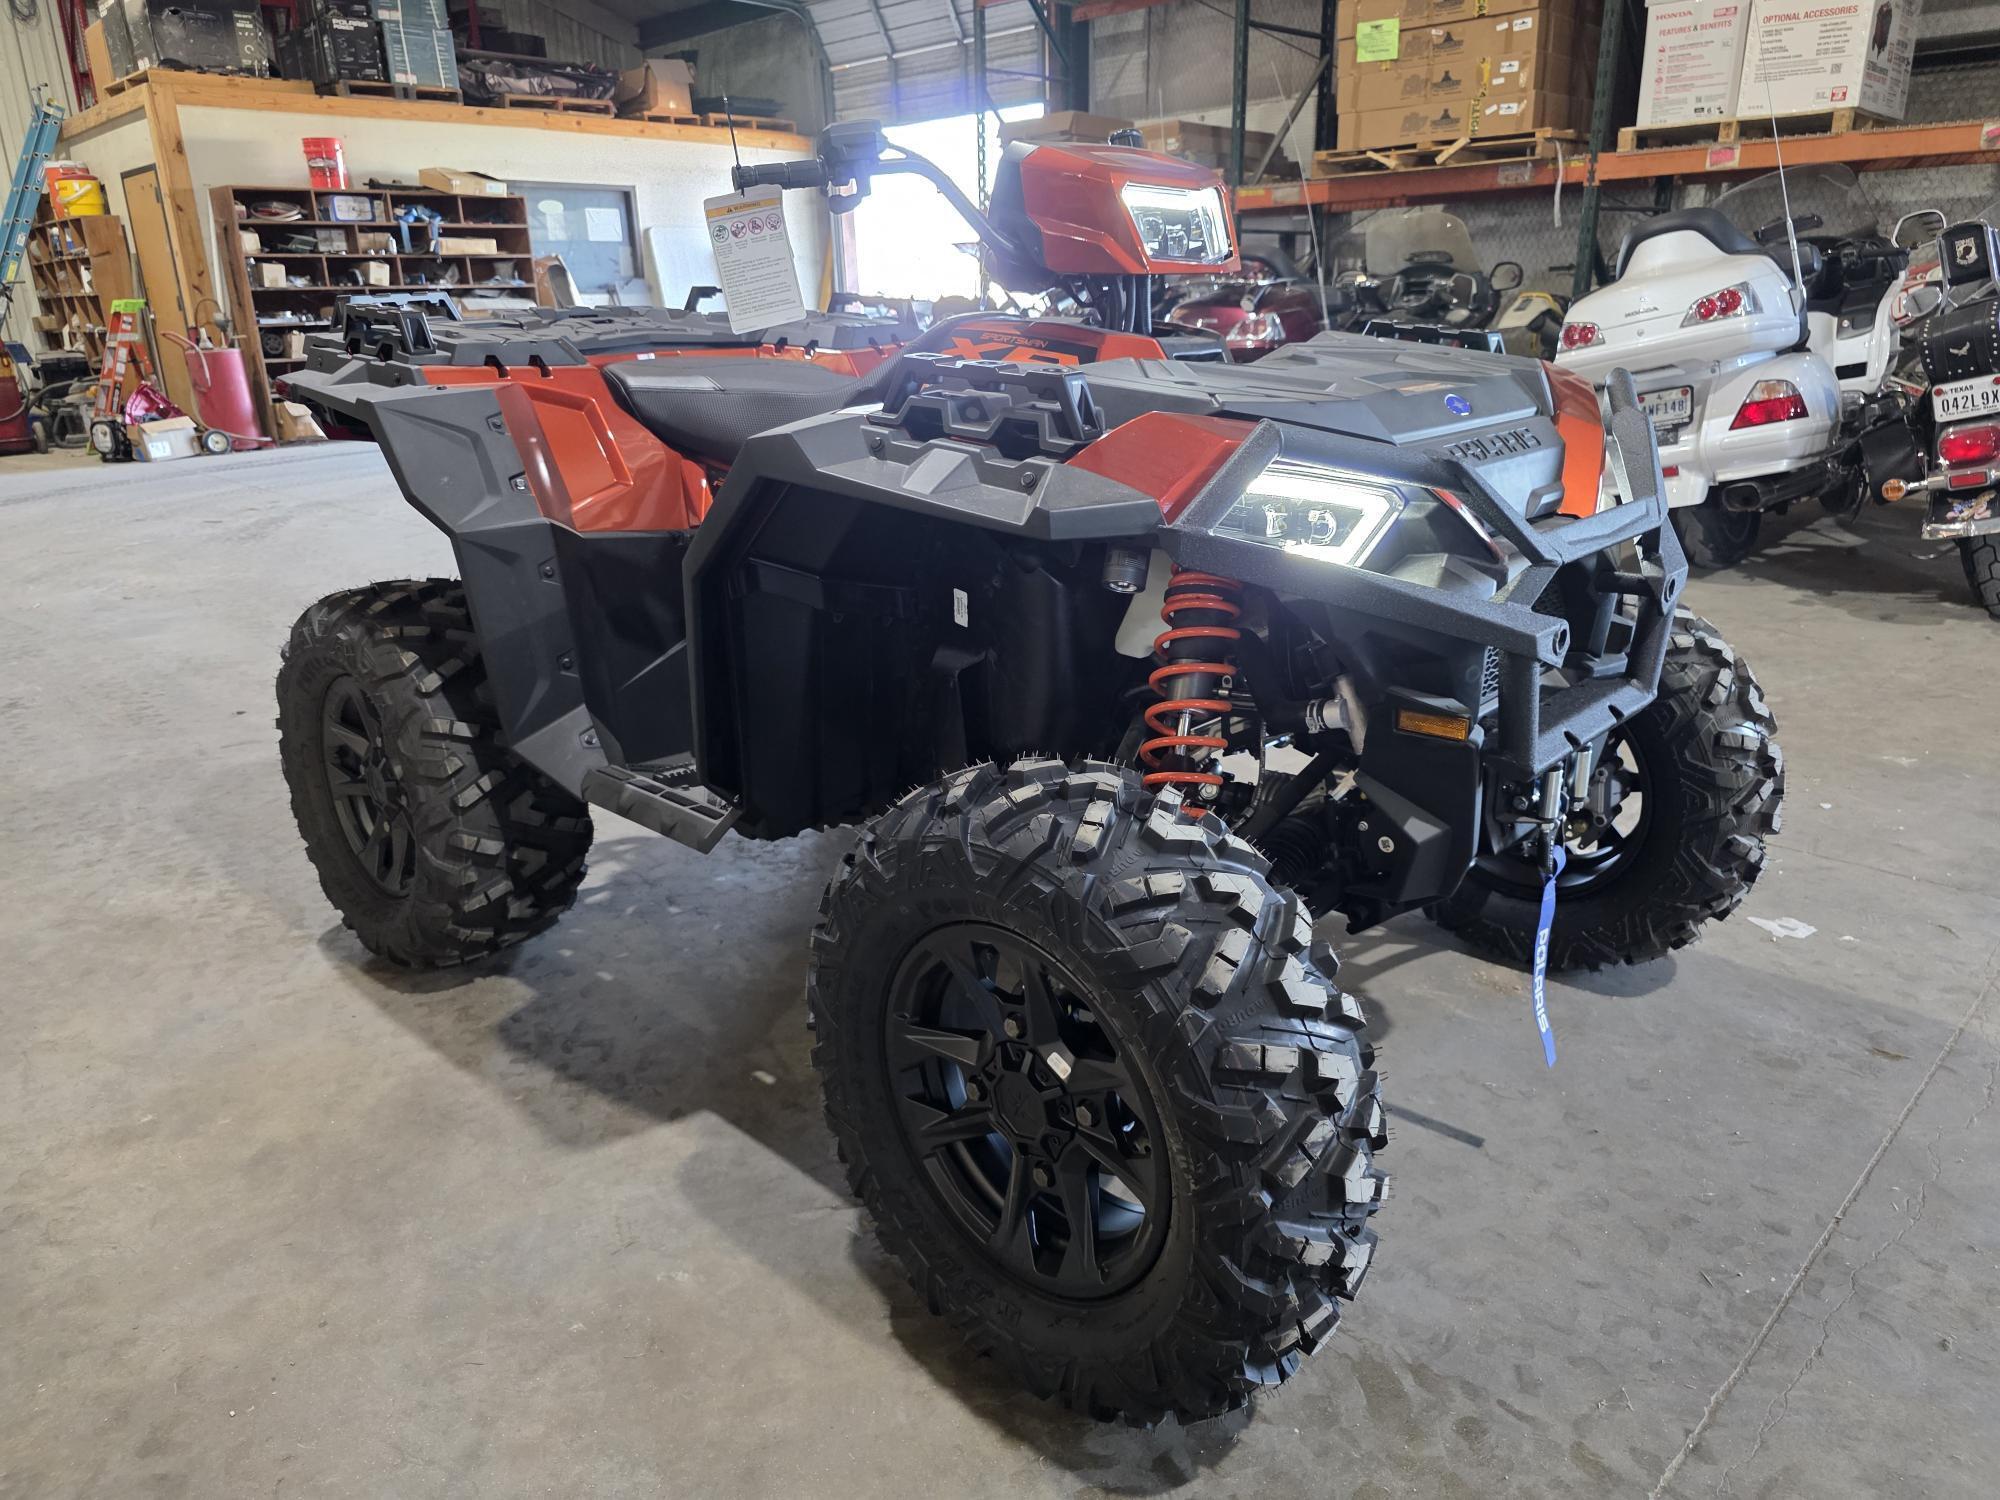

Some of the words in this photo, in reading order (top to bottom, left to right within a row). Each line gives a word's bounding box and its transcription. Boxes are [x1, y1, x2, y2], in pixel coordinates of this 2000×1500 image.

[1656, 10, 1694, 20] HONDA
[1763, 12, 1801, 24] OPTIONAL
[1803, 5, 1859, 20] ACCESSORIES
[1659, 26, 1692, 37] FEATURES
[1700, 20, 1733, 31] BENEFITS
[980, 332, 1049, 349] SPORTSMAN
[1950, 384, 1974, 394] TEXAS
[1941, 389, 2000, 413] 042L9X
[1443, 427, 1542, 461] POLARIS
[1534, 927, 1550, 1034] POLARIS
